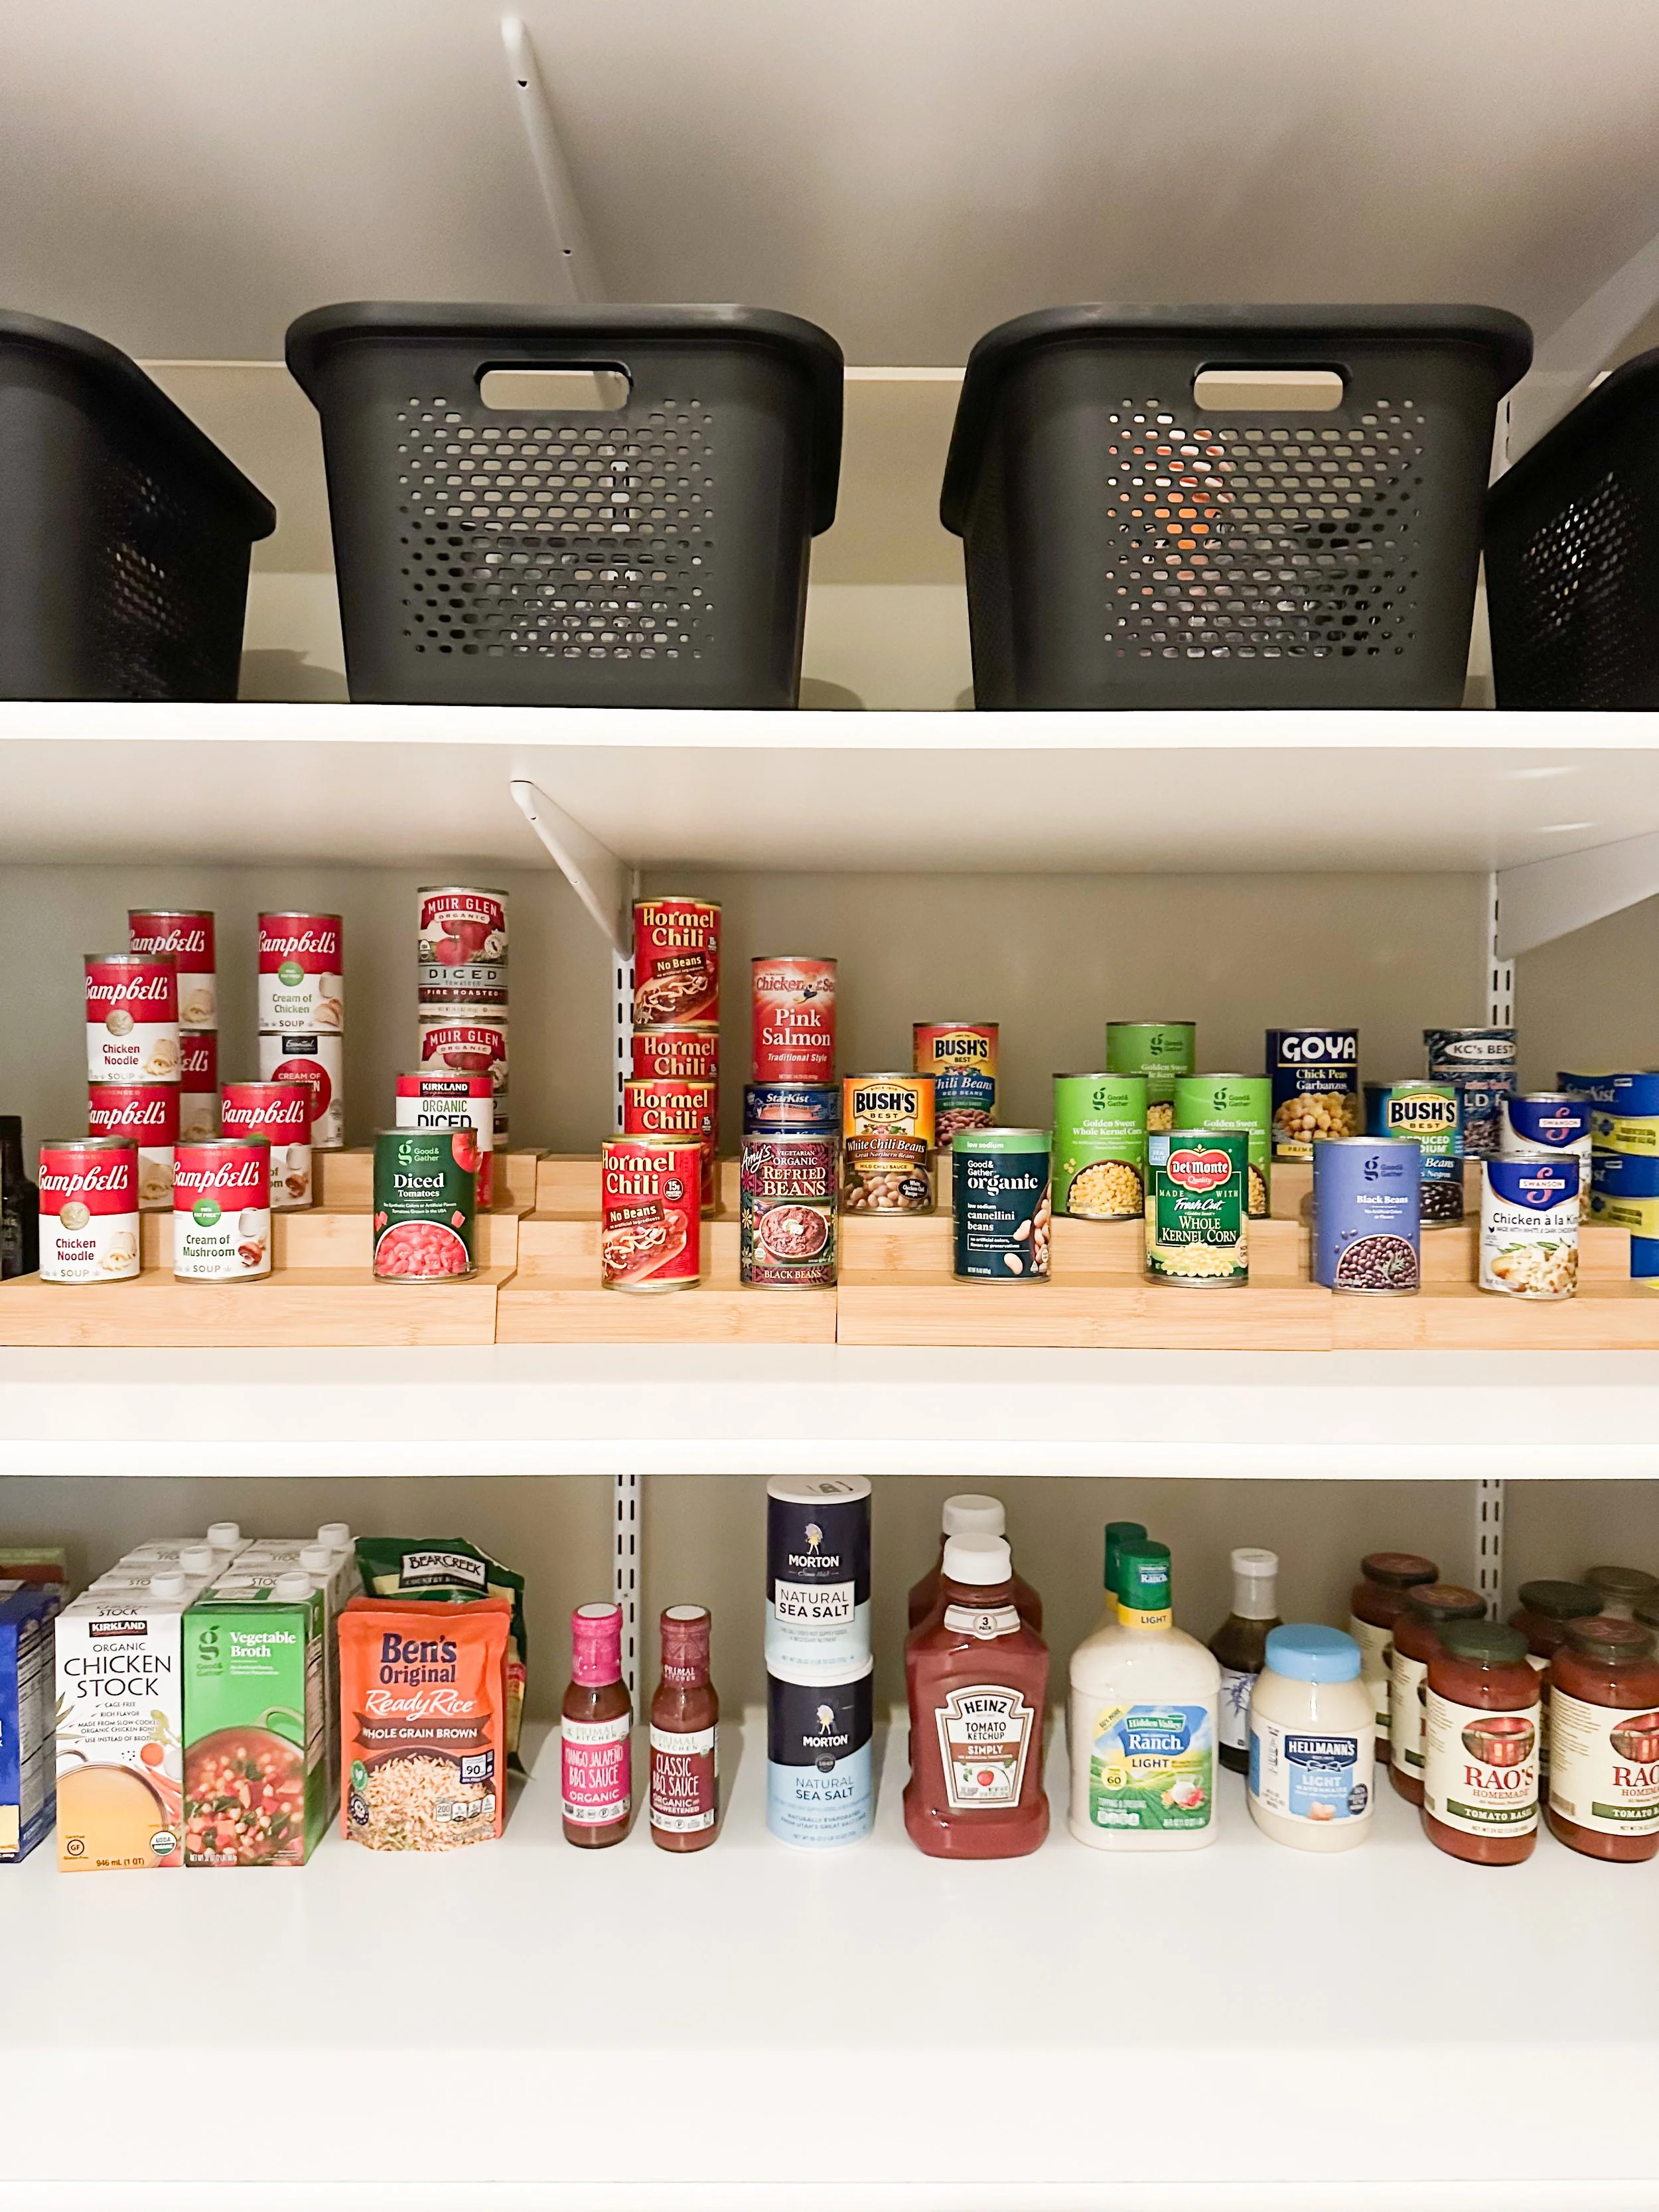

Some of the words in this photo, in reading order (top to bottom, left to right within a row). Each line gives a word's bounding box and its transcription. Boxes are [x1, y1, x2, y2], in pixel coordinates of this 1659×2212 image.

[428, 897, 459, 914] MUIR
[466, 898, 497, 916] GLEN
[643, 909, 714, 928] Hormel
[258, 931, 335, 956] Campbell's
[652, 928, 703, 947] Chili
[658, 960, 671, 971] No
[674, 956, 702, 968] Beans
[429, 970, 496, 980] DICED
[775, 1009, 821, 1027] Pink
[429, 1029, 462, 1047] MUIR
[467, 1030, 498, 1046] GLEN
[762, 1028, 830, 1046] Salmon
[102, 1044, 140, 1053] Chicken
[644, 1038, 715, 1057] Hormel
[936, 1040, 987, 1058] BUSH'S
[1282, 1037, 1355, 1061] GOYA
[1488, 1045, 1513, 1054] BEST
[104, 1056, 139, 1065] Noodle
[811, 1054, 827, 1063] Style
[654, 1059, 705, 1075] Chili
[1296, 1069, 1326, 1078] Chick
[1329, 1070, 1348, 1078] Peas
[1296, 1081, 1348, 1090] Garbanzos
[633, 1090, 708, 1108] Hormel
[766, 1094, 810, 1102] StarKist
[856, 1093, 915, 1113] BUSH'S
[222, 1100, 304, 1124] Campbell's
[423, 1100, 467, 1112] ORGANIC
[1392, 1102, 1455, 1123] BUSH'S
[643, 1111, 697, 1129] Chili
[848, 1139, 869, 1151] White
[870, 1139, 896, 1150] Chili
[897, 1140, 925, 1153] Beans
[603, 1149, 674, 1171] Hormel
[1173, 1161, 1190, 1173] Del
[1192, 1162, 1228, 1173] Monte
[1425, 1158, 1454, 1167] Beans
[173, 1162, 259, 1193] Campbell's
[763, 1166, 826, 1179] REFRIED
[38, 1165, 128, 1196] Campbell's
[394, 1173, 444, 1188] Diced
[607, 1173, 659, 1194] Chili
[968, 1174, 1038, 1196] organic
[764, 1181, 826, 1195] BEANS
[611, 1211, 622, 1222] No
[623, 1205, 656, 1219] Beans
[968, 1222, 993, 1230] beans
[56, 1238, 96, 1248] Chicken
[186, 1235, 217, 1244] Cream
[220, 1235, 230, 1244] of
[57, 1252, 94, 1260] Noodle
[183, 1247, 234, 1256] Mushroom
[788, 1554, 839, 1568] MORTON
[781, 1589, 848, 1603] NATURAL
[780, 1603, 808, 1617] SEA
[812, 1604, 849, 1617] SALT
[92, 1622, 145, 1631] KIRKLAND
[230, 1631, 296, 1646] Vegetable
[93, 1643, 146, 1652] ORGANIC
[231, 1645, 271, 1657] Broth
[381, 1633, 457, 1663] Ben's
[64, 1655, 171, 1676] CHICKEN
[664, 1665, 695, 1675] PRIMAL
[380, 1664, 455, 1687] Original
[77, 1678, 159, 1698] STOCK
[366, 1689, 427, 1722] Ready
[429, 1688, 475, 1716] Rice
[964, 1700, 1007, 1714] HEINZ
[966, 1722, 1006, 1732] TOMATO
[1129, 1720, 1158, 1728] Hidden
[1159, 1720, 1181, 1729] Valley
[363, 1728, 396, 1739] WHOLE
[399, 1729, 434, 1738] GRAIN
[436, 1728, 477, 1738] BROWN
[803, 1735, 848, 1747] MORTON
[1129, 1733, 1184, 1749] Ranch
[968, 1745, 1004, 1755] SIMPLY
[1289, 1741, 1355, 1756] HELLMANN'S
[467, 1765, 480, 1774] 90
[656, 1753, 691, 1777] CLASSIC
[569, 1766, 586, 1788] BBQ
[589, 1765, 619, 1788] SAUCE
[796, 1776, 854, 1789] NATURAL
[1303, 1775, 1342, 1787] LIGHT
[1464, 1765, 1534, 1789] RAO'S
[653, 1771, 666, 1796] BBQ
[669, 1776, 699, 1797] SAUCE
[569, 1789, 619, 1803] ORGANIC
[653, 1793, 692, 1807] ORGANIC
[796, 1790, 820, 1800] SEA
[825, 1787, 854, 1800] SALT
[1473, 1789, 1529, 1799] HOMEMADE
[1613, 1808, 1652, 1817] TOMATO
